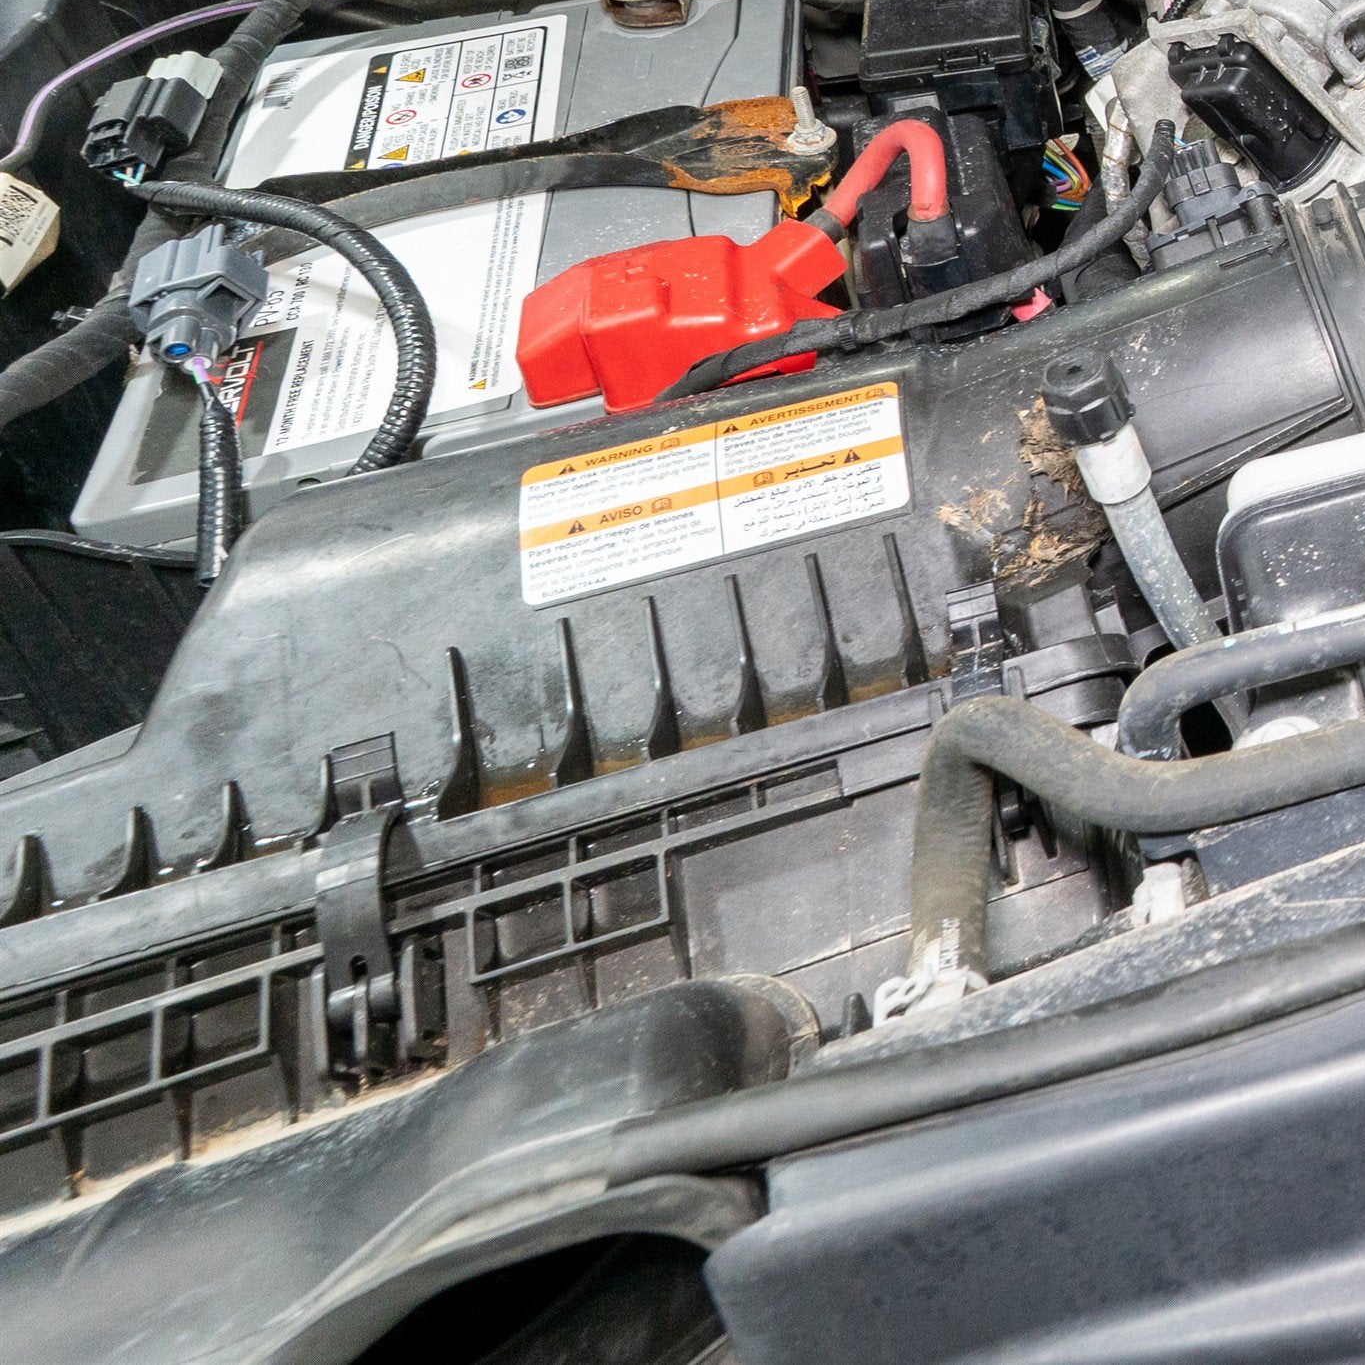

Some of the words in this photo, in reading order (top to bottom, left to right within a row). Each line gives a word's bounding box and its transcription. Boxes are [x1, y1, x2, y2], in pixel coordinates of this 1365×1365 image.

[355, 86, 381, 149] DANGER/POISON
[299, 262, 312, 275] 130
[295, 276, 309, 286] RC
[290, 290, 305, 304] 700
[286, 306, 300, 321] CCA
[291, 340, 313, 387] REPLACEMENT
[286, 389, 301, 407] FREE
[750, 394, 859, 425] AVERTISSEMENT
[276, 408, 294, 445] 12-MONTH
[724, 434, 745, 442] Pour
[795, 415, 823, 425] risque
[840, 401, 883, 414] blessures
[586, 444, 653, 466] WARNING
[724, 439, 755, 451] graves
[543, 477, 576, 487] reduce
[613, 458, 653, 472] possible
[657, 448, 691, 460] serious
[528, 491, 555, 501] injury
[600, 505, 642, 524] AVISO
[528, 548, 551, 557] Para
[555, 538, 589, 550] reducir
[605, 526, 635, 537] riesgo
[654, 511, 693, 525] lesiones
[529, 555, 568, 568] severas
[639, 532, 654, 540] use
[658, 523, 687, 535] fluidos
